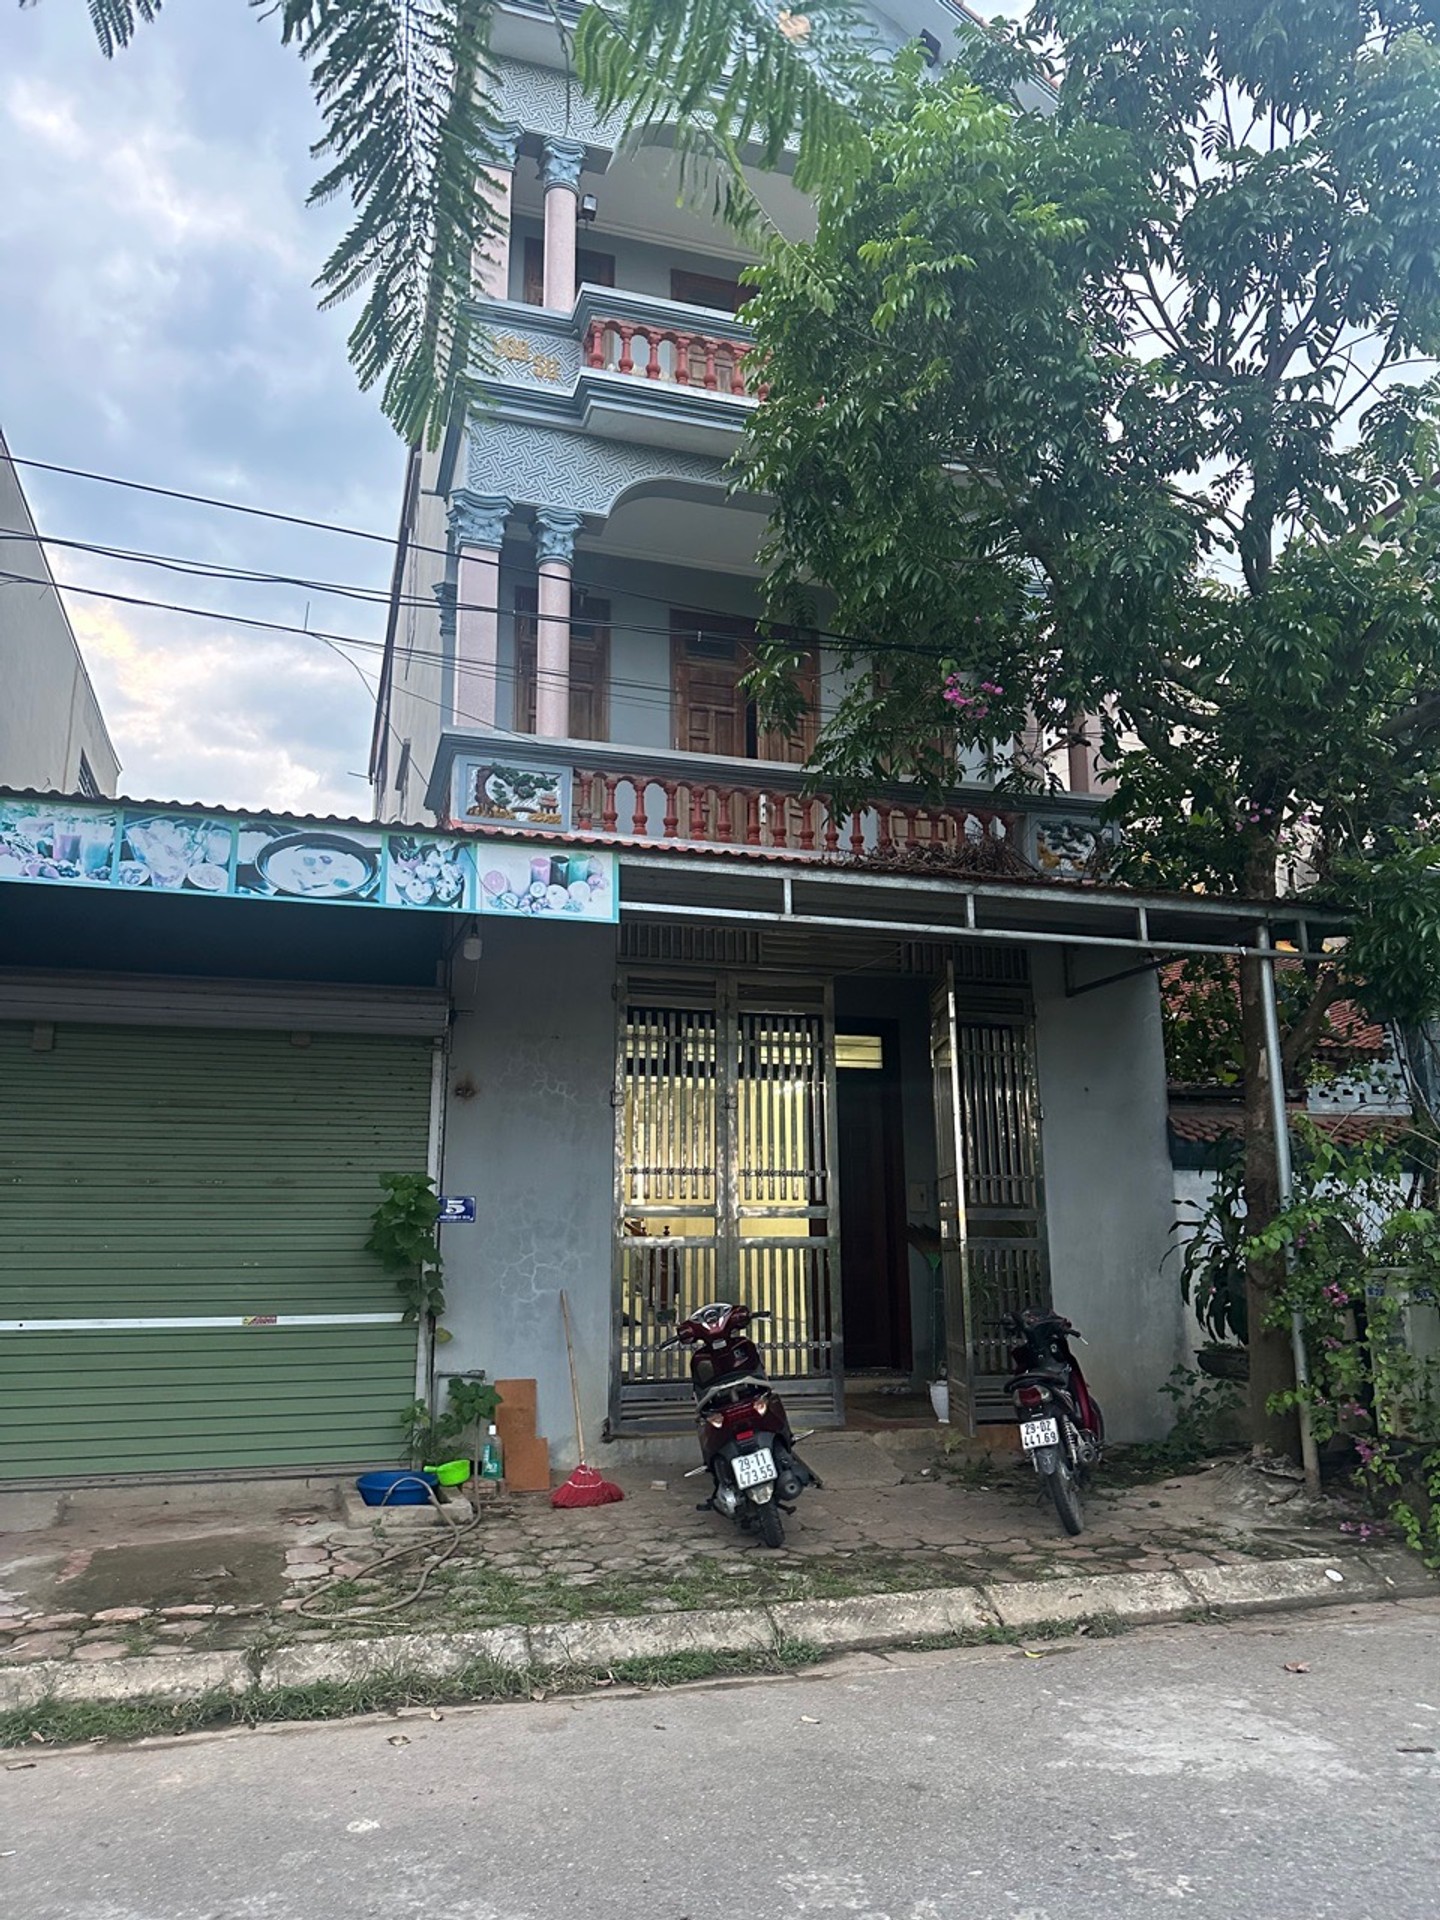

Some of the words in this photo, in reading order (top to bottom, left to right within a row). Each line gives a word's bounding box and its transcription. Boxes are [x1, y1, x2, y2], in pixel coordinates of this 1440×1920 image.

[446, 1198, 466, 1214] 5
[738, 1452, 766, 1472] 29-T1
[740, 1464, 773, 1485] 473.55
